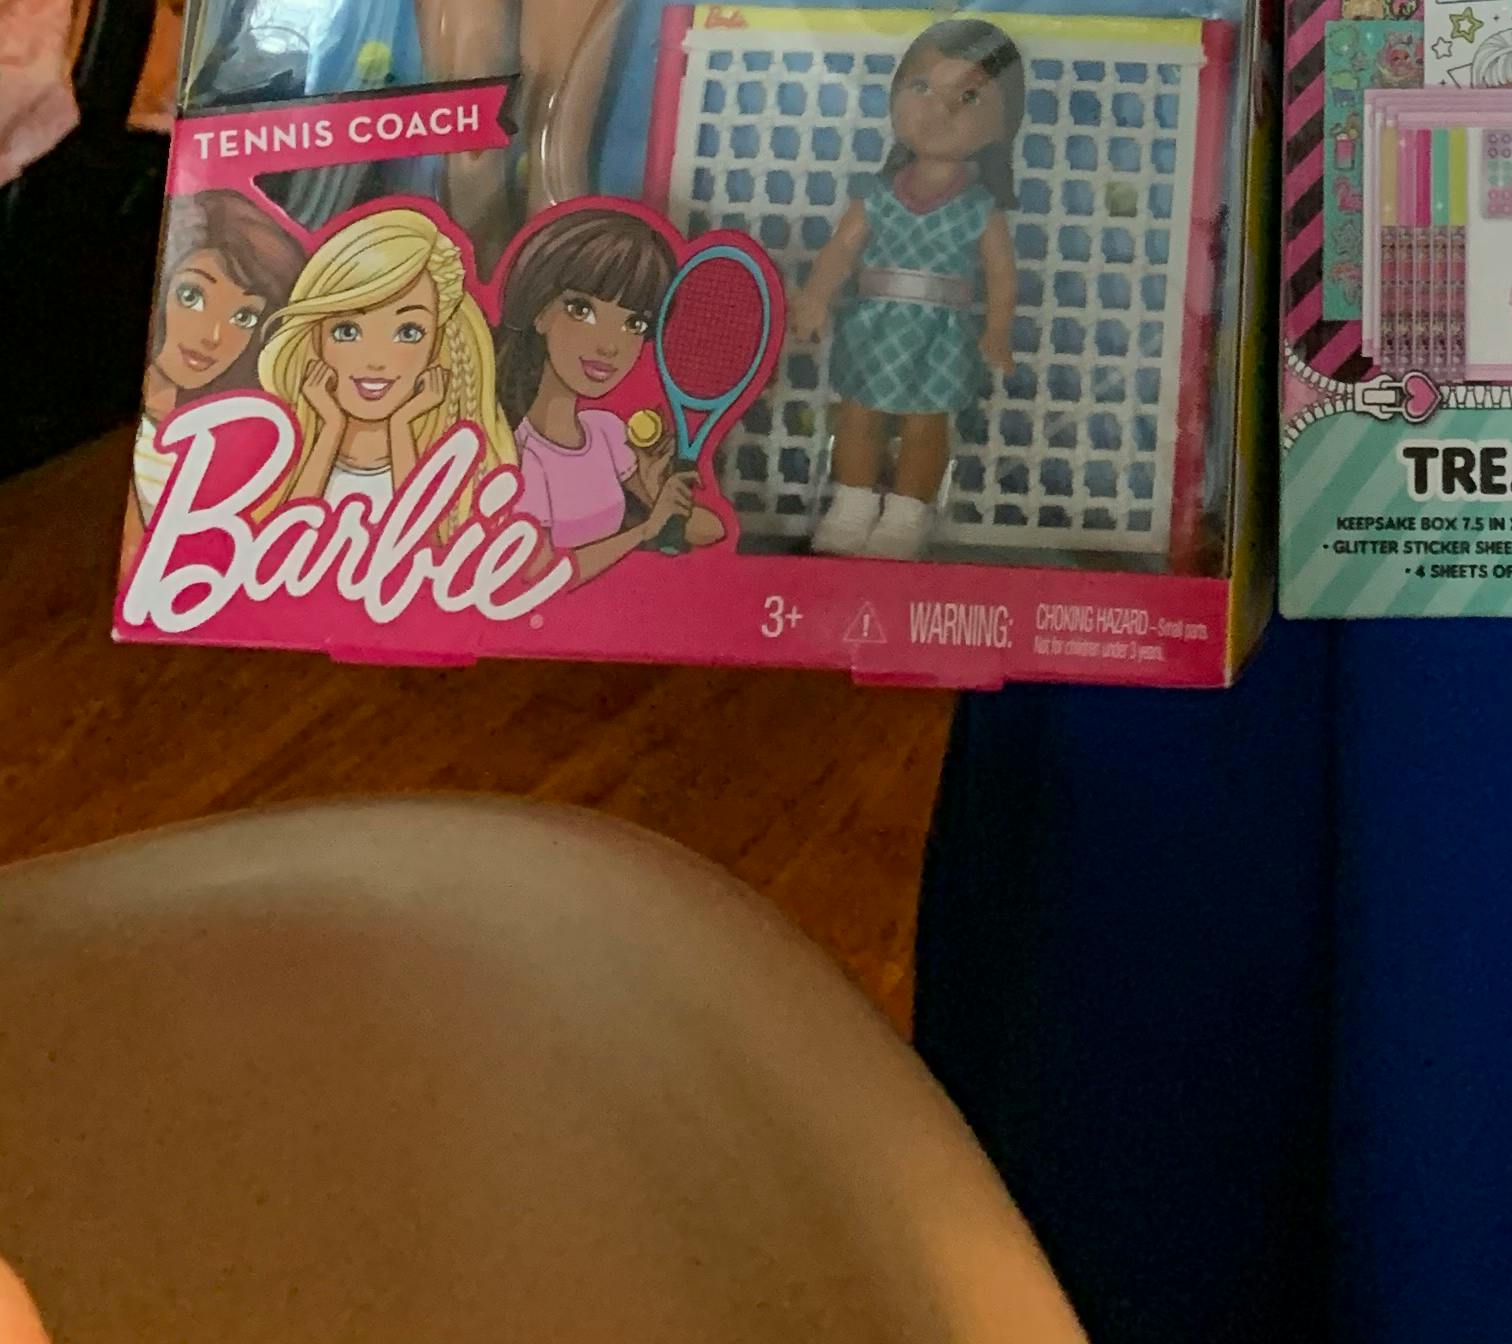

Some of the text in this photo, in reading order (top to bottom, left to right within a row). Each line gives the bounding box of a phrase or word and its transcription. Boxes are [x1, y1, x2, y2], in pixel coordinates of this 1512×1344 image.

[194, 105, 480, 160] TENNIS COACH
[122, 395, 573, 633] Barbie
[1336, 517, 1416, 531] KEEPSAKE
[1420, 517, 1457, 531] BOX
[1462, 517, 1484, 531] 7.5
[1489, 517, 1505, 531] IN
[1333, 540, 1399, 555] GLITTER
[1403, 540, 1470, 555] STICKER
[1415, 565, 1426, 579] 4
[1430, 564, 1488, 579] SHEETS
[760, 594, 1014, 650] 3+ WARNING:
[1036, 603, 1094, 633] CHOKING
[1097, 608, 1149, 635] HAZARD
